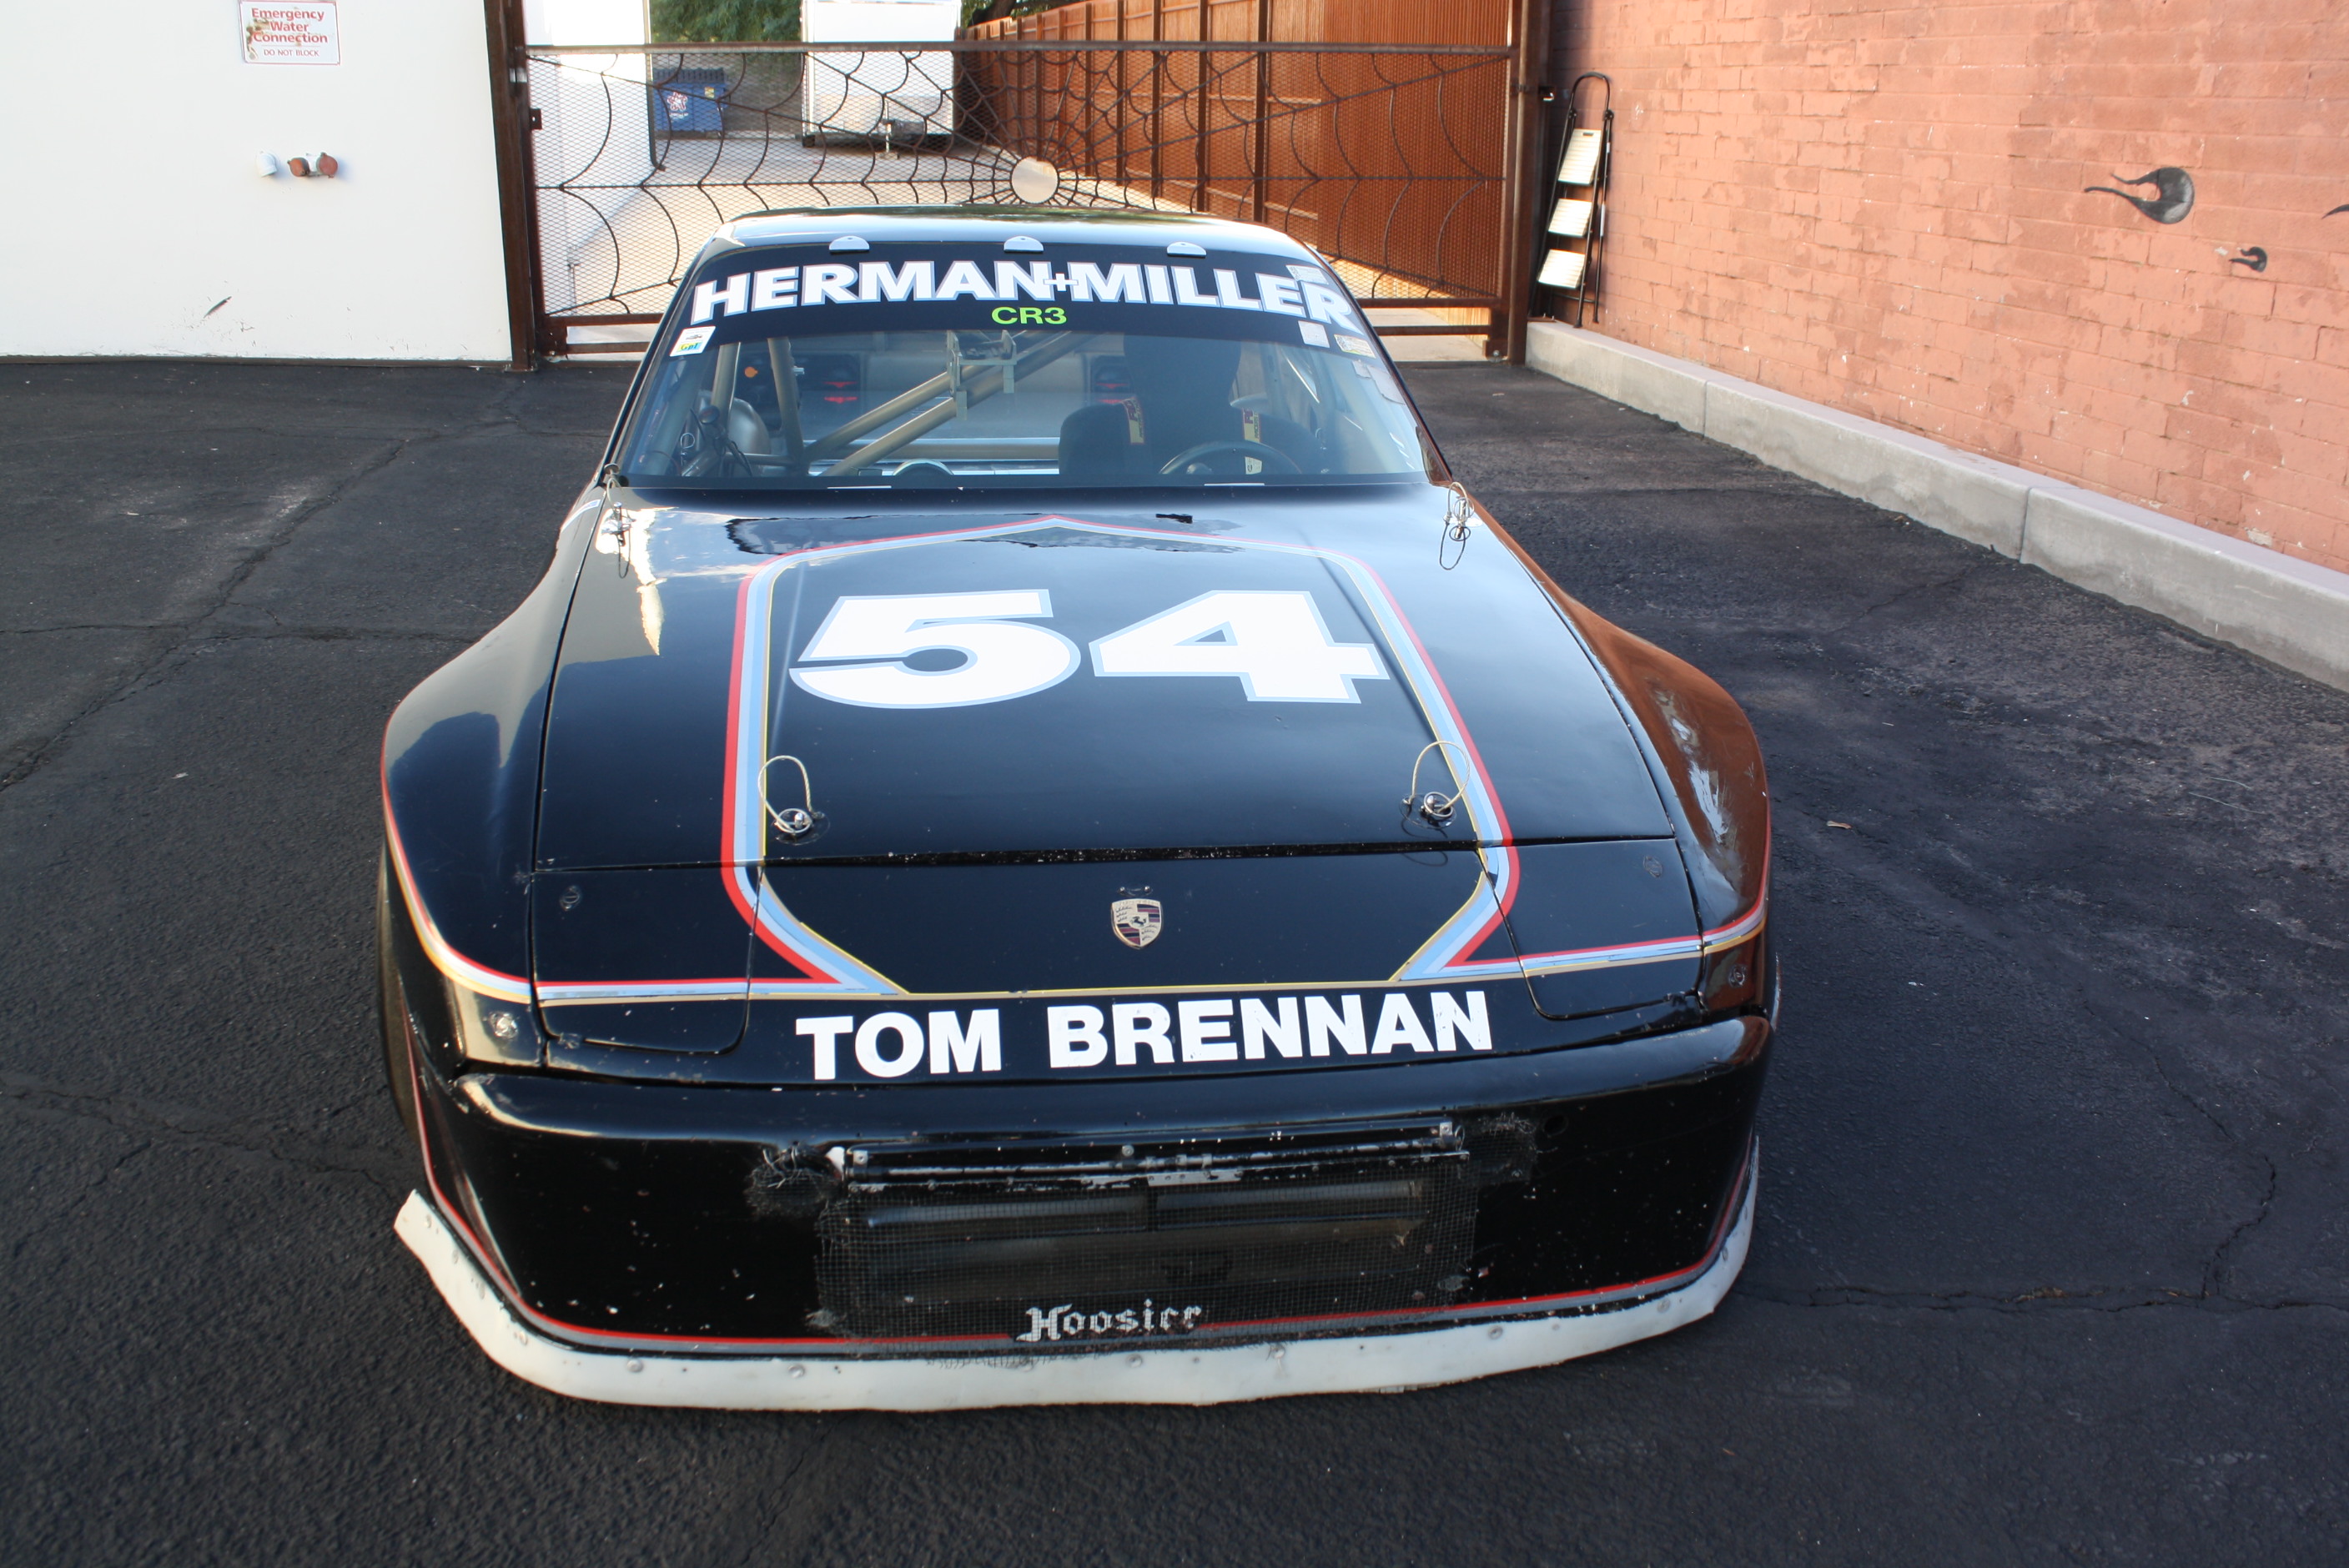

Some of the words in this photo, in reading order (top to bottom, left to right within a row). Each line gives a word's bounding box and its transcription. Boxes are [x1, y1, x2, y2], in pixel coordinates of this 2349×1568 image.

[251, 8, 324, 21] Emergency
[269, 22, 309, 32] Water
[253, 33, 328, 43] Connection
[991, 306, 1067, 324] CR3
[788, 589, 1391, 709] 54
[796, 1008, 1002, 1081] TOM
[1046, 990, 1493, 1068] BRENNAN
[1015, 1298, 1203, 1343] Hoosier
